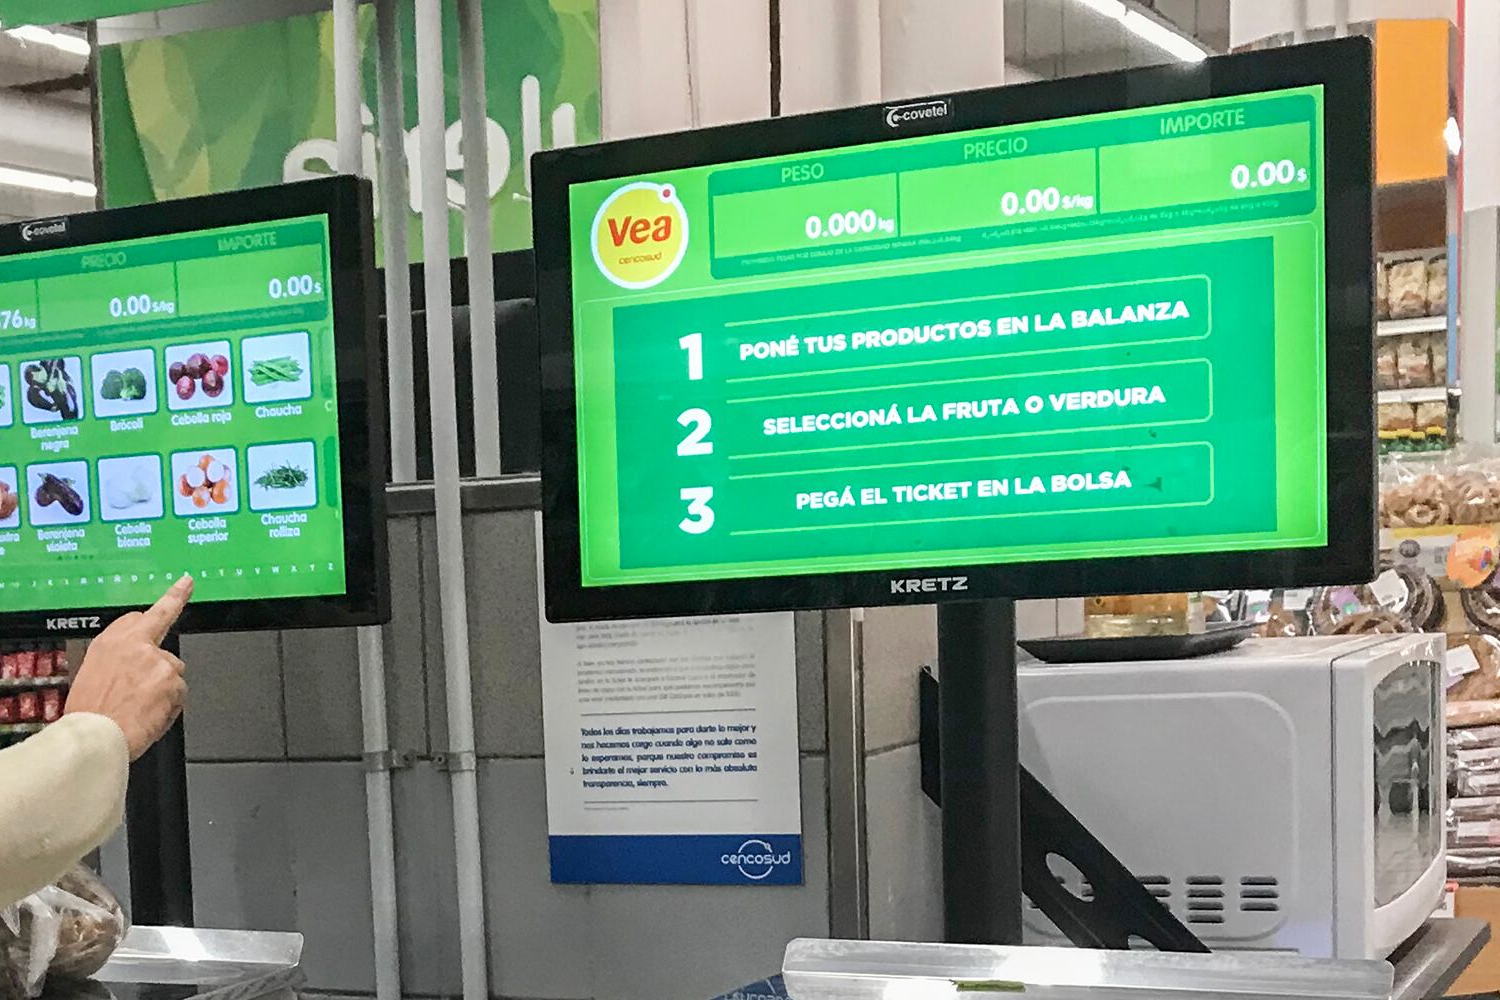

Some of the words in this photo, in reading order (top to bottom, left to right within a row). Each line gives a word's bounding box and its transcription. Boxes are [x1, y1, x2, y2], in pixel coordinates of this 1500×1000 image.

[781, 162, 824, 182] PESO
[964, 137, 1027, 160] PRECIO
[1160, 108, 1245, 135] IMPORTE
[1231, 160, 1295, 189] 0.00
[1001, 187, 1060, 216] 0.00
[608, 215, 673, 247] Vea
[805, 209, 876, 239] 0.000
[217, 231, 277, 251] IMPORTE
[268, 274, 313, 299] 0.00
[109, 294, 151, 317] 0.00
[679, 333, 703, 380] 1
[740, 334, 799, 360] PONÉ
[804, 333, 847, 354] TUS
[852, 319, 991, 350] PRODUCTOS
[997, 316, 1028, 336] EN
[1034, 312, 1066, 332] LA
[1071, 300, 1190, 328] BALANZA
[255, 403, 302, 418] Chaucha
[171, 412, 211, 427] Cebolla
[211, 411, 232, 426] roja
[677, 407, 713, 456] 2
[763, 403, 902, 435] SELECCIONÁ
[907, 404, 938, 423] LA
[942, 397, 1020, 420] FRUTA
[1024, 396, 1044, 413] O
[1049, 385, 1166, 411] VERDURA
[679, 486, 715, 534] 3
[796, 484, 855, 509] PEGÁ
[861, 488, 888, 504] EL
[892, 481, 972, 502] TICKET
[977, 479, 1009, 497] EN
[1014, 476, 1046, 494] LA
[1051, 470, 1132, 492] BOLSA
[188, 517, 226, 530] Cebolla
[261, 511, 308, 526] Chaucha
[115, 523, 152, 536] Cebolla
[188, 530, 229, 545] superior
[269, 525, 300, 538] rolliza
[117, 535, 151, 549] blanca
[891, 577, 968, 594] KRETZ
[46, 615, 100, 631] KRETZ
[581, 727, 602, 737] Todos
[631, 725, 675, 737] trabajamos
[676, 726, 695, 736] para
[696, 725, 717, 734] darte
[727, 724, 750, 734] mejor
[596, 741, 630, 749] hacemos
[654, 739, 684, 748] cuando
[685, 738, 703, 749] algo
[666, 752, 695, 761] nuestro
[697, 751, 745, 761] compromiso
[582, 766, 616, 775] brindarte
[626, 765, 648, 775] mejor
[650, 765, 678, 774] servicio
[721, 851, 791, 864] cencosud
